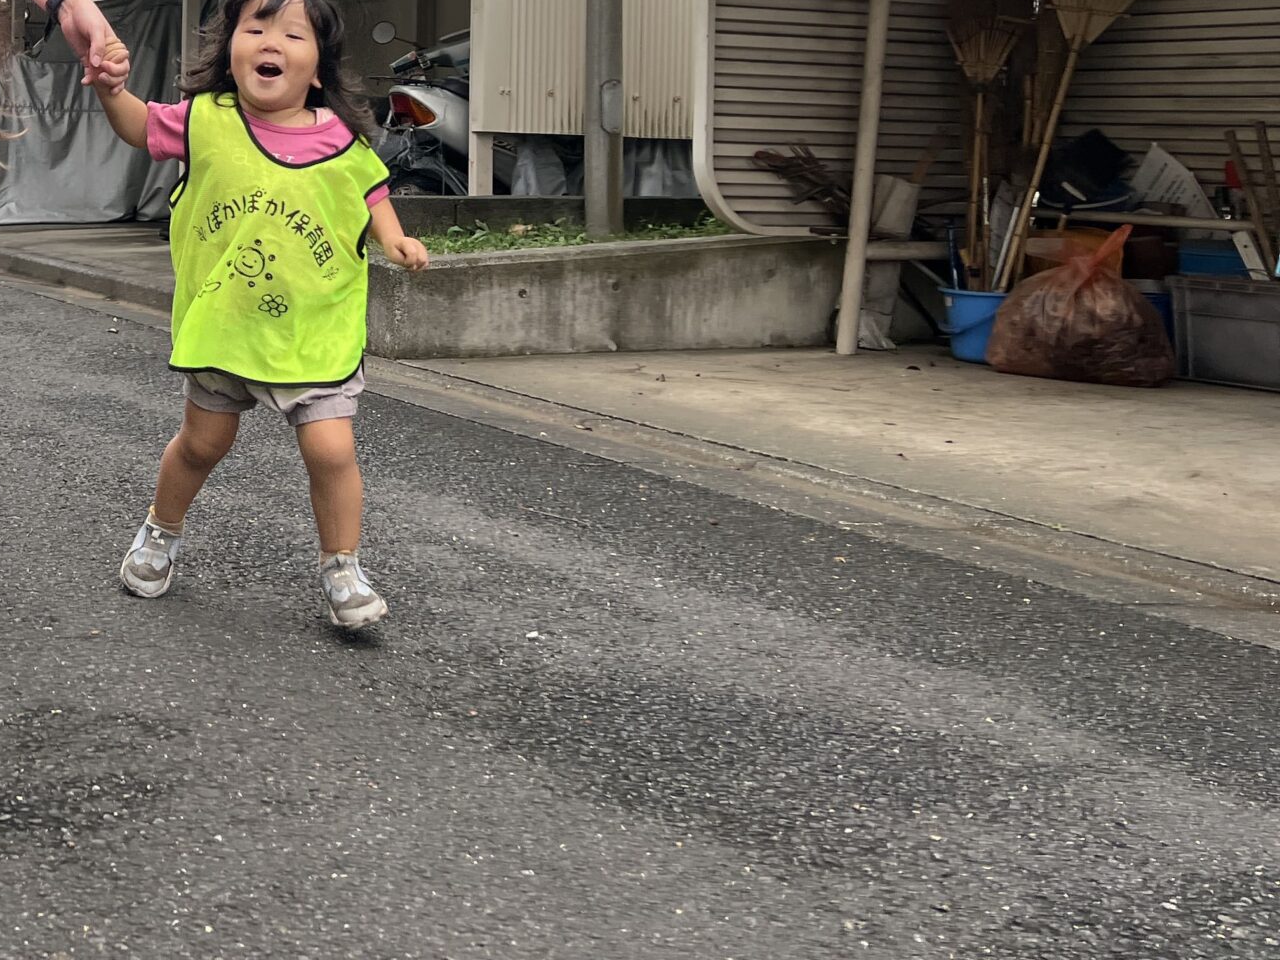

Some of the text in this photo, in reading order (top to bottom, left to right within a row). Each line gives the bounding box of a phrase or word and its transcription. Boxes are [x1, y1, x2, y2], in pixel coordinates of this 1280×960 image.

[206, 187, 334, 268] ぽかぽか保育園
